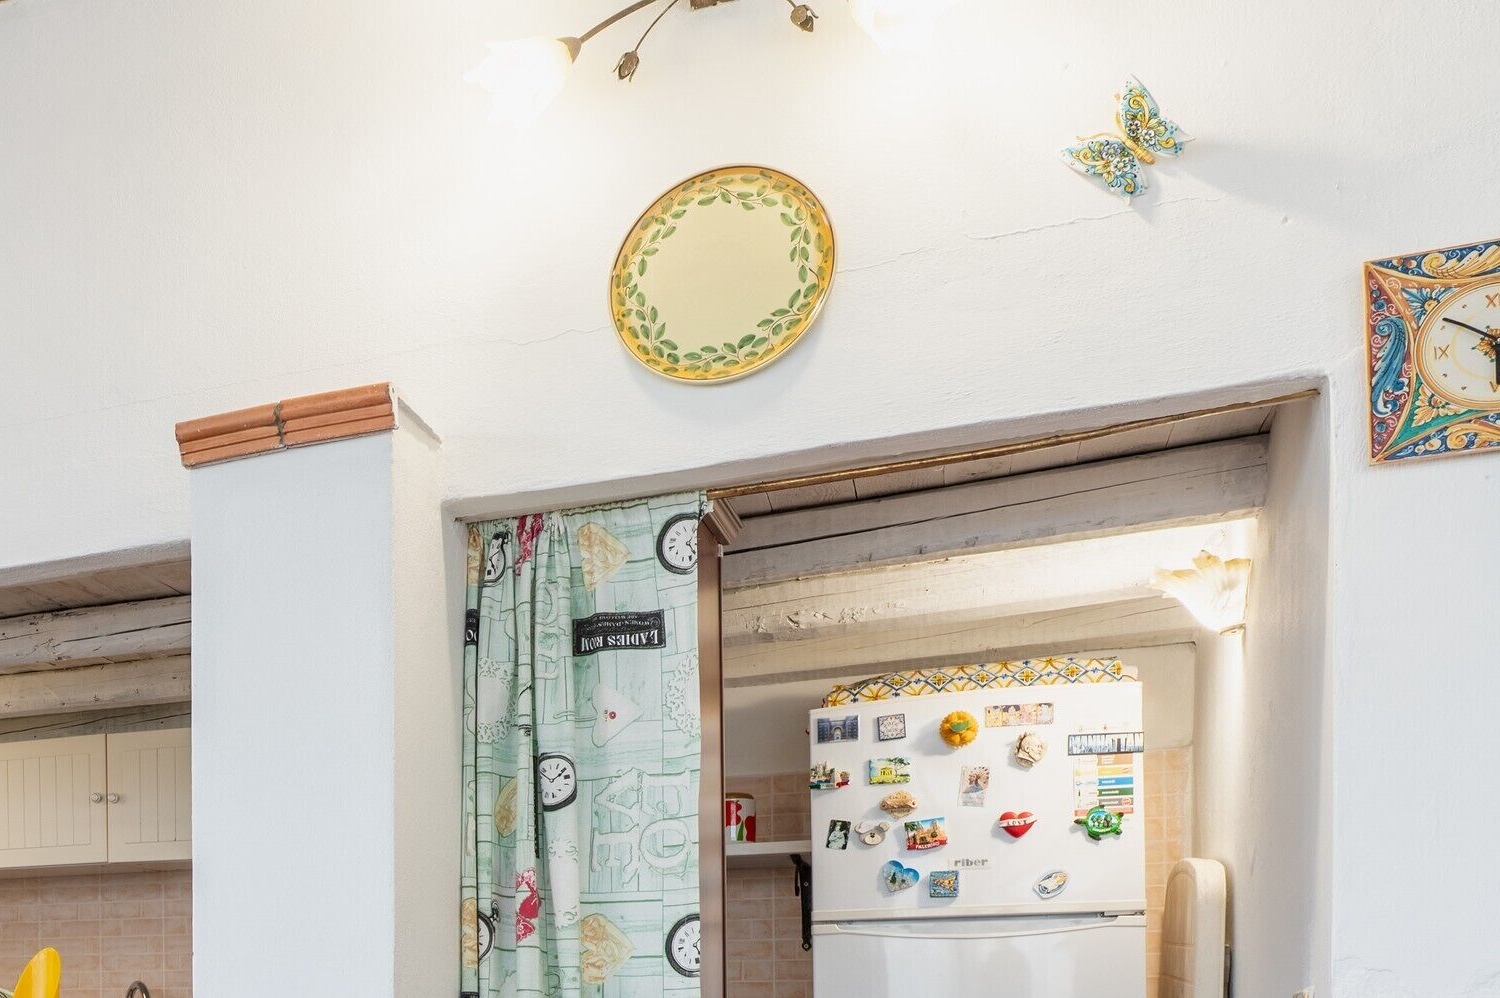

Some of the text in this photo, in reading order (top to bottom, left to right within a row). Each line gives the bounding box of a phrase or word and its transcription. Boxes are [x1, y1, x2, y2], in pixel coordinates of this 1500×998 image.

[1433, 344, 1451, 360] IX
[607, 629, 659, 646] LADIES
[1006, 819, 1028, 827] LOVE
[954, 858, 988, 867] riber
